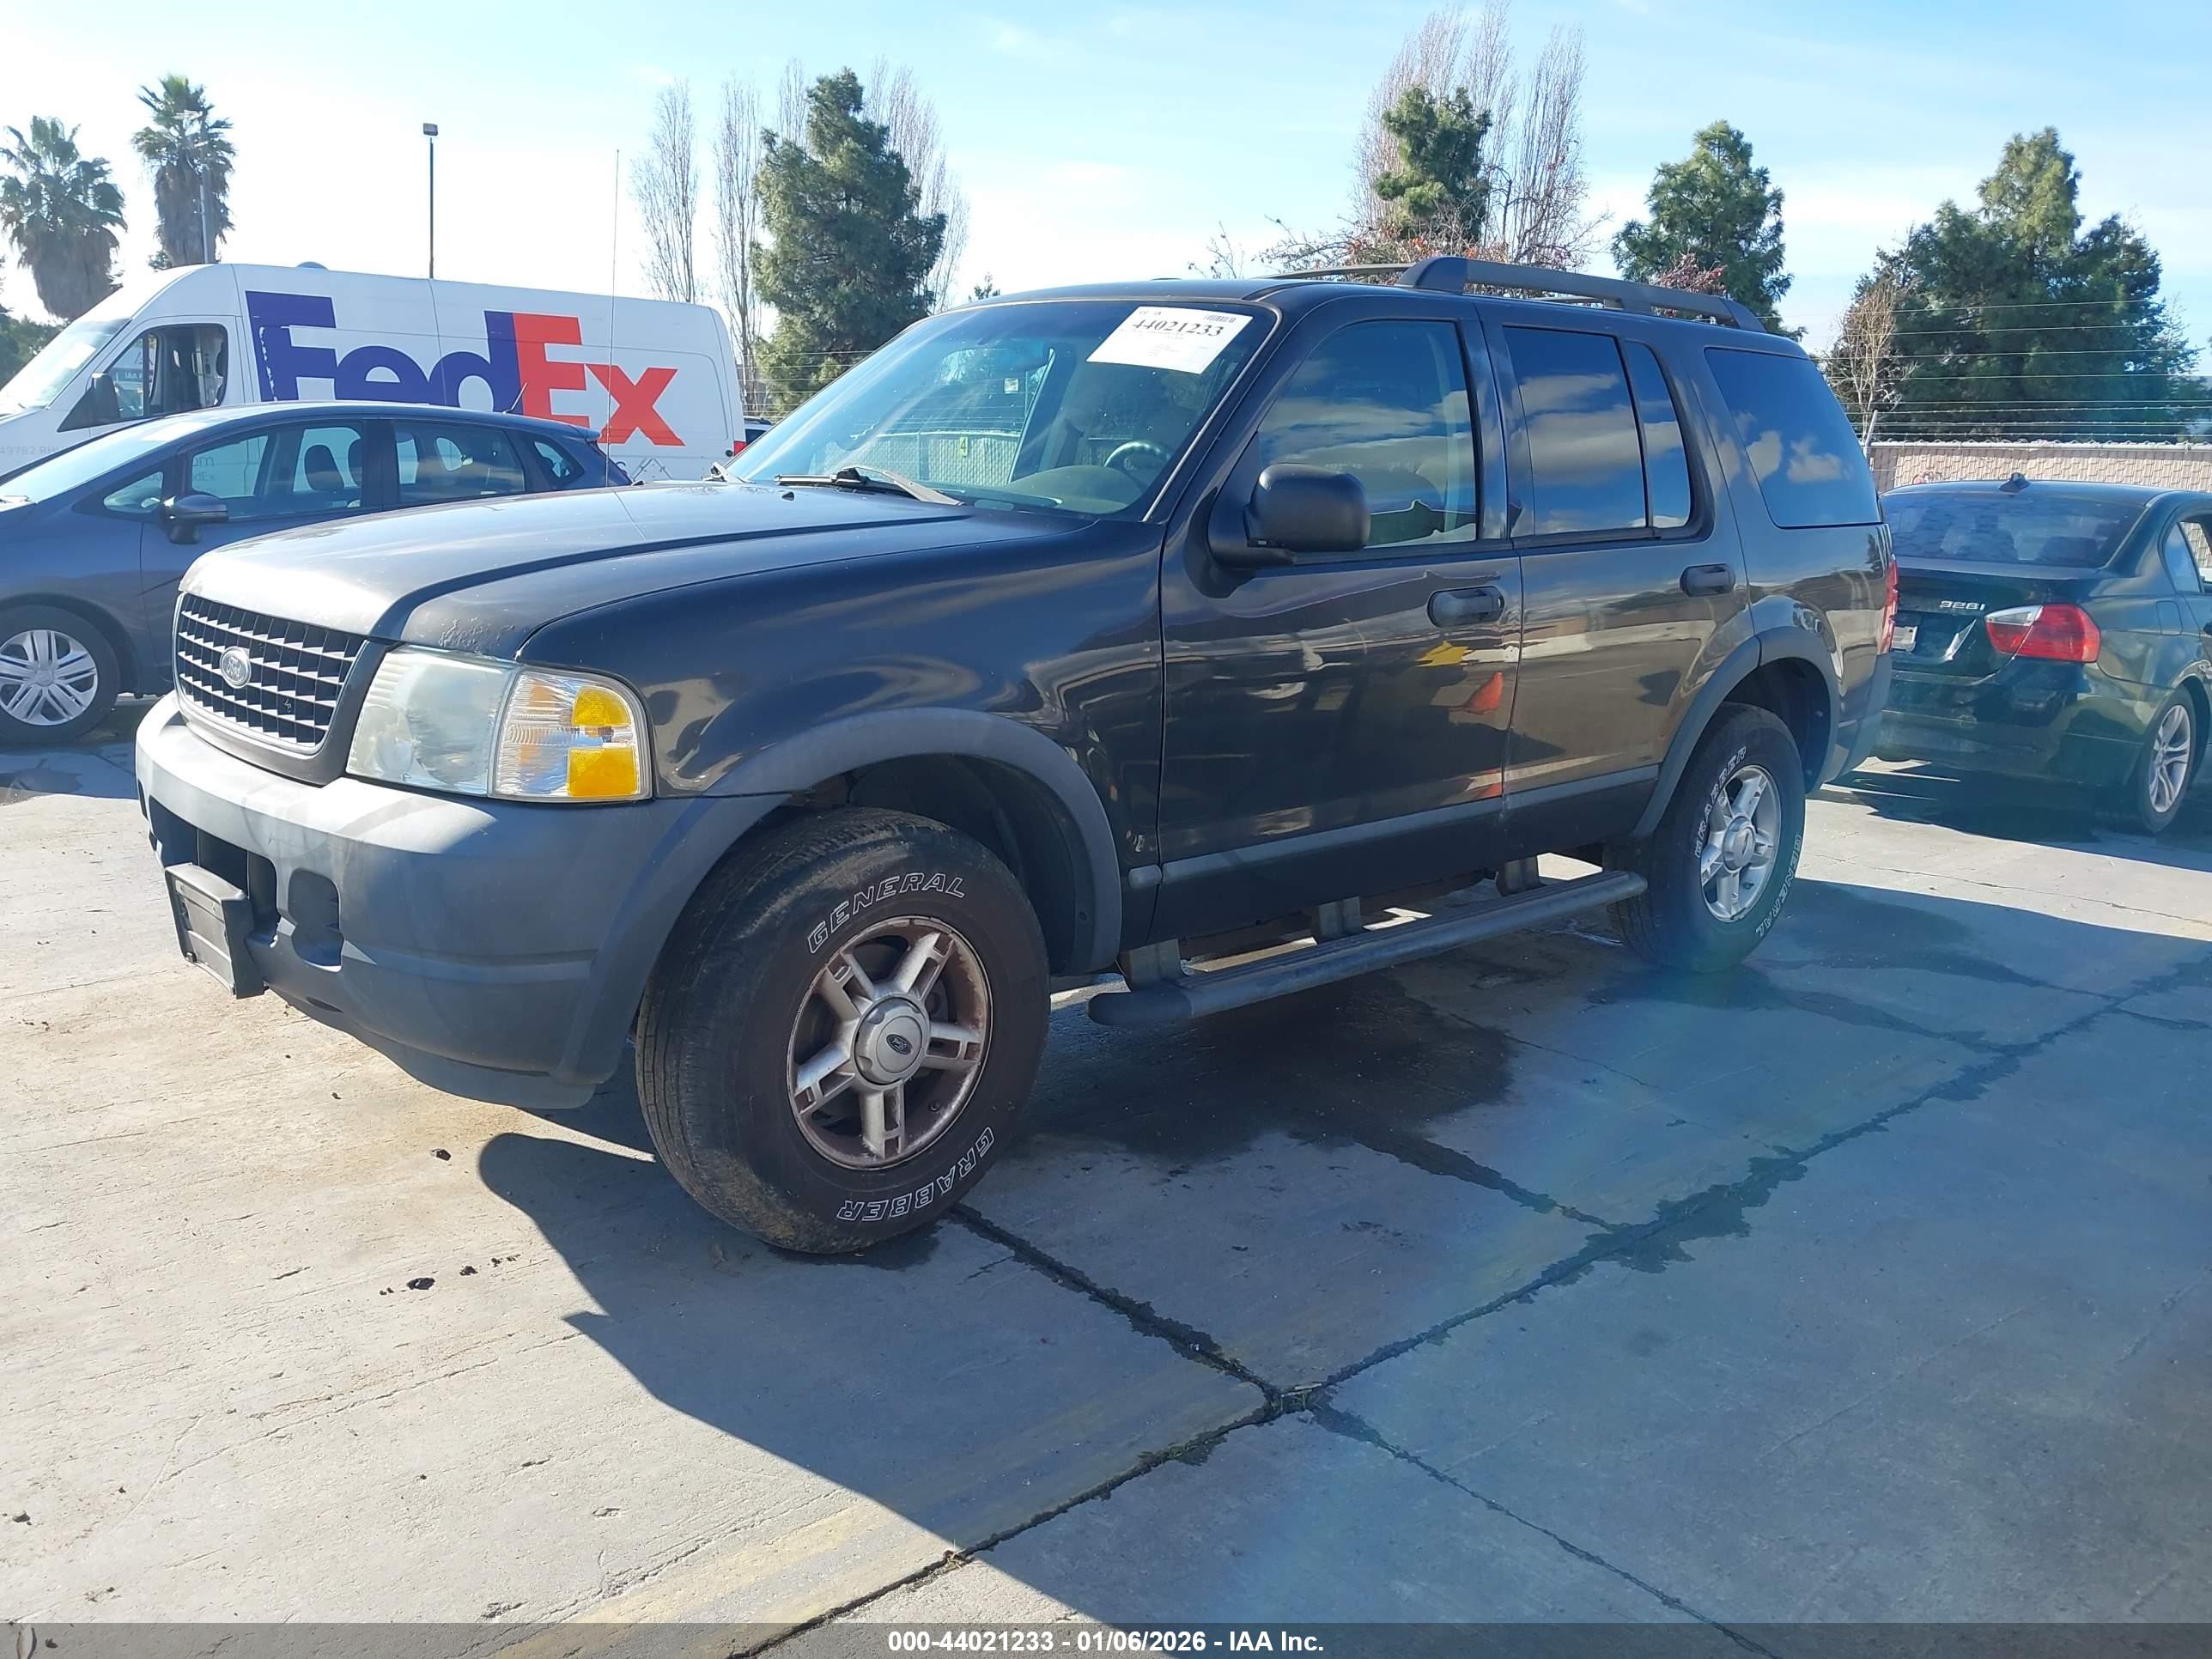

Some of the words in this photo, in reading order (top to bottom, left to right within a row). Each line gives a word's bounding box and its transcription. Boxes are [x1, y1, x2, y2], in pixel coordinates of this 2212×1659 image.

[245, 290, 685, 447] FedEx
[1132, 319, 1224, 337] 44021233
[1695, 745, 1747, 859] GRABBER
[807, 872, 966, 954] GENERAL
[1756, 834, 1802, 937] GENERAL
[836, 1127, 995, 1222] GRABBER
